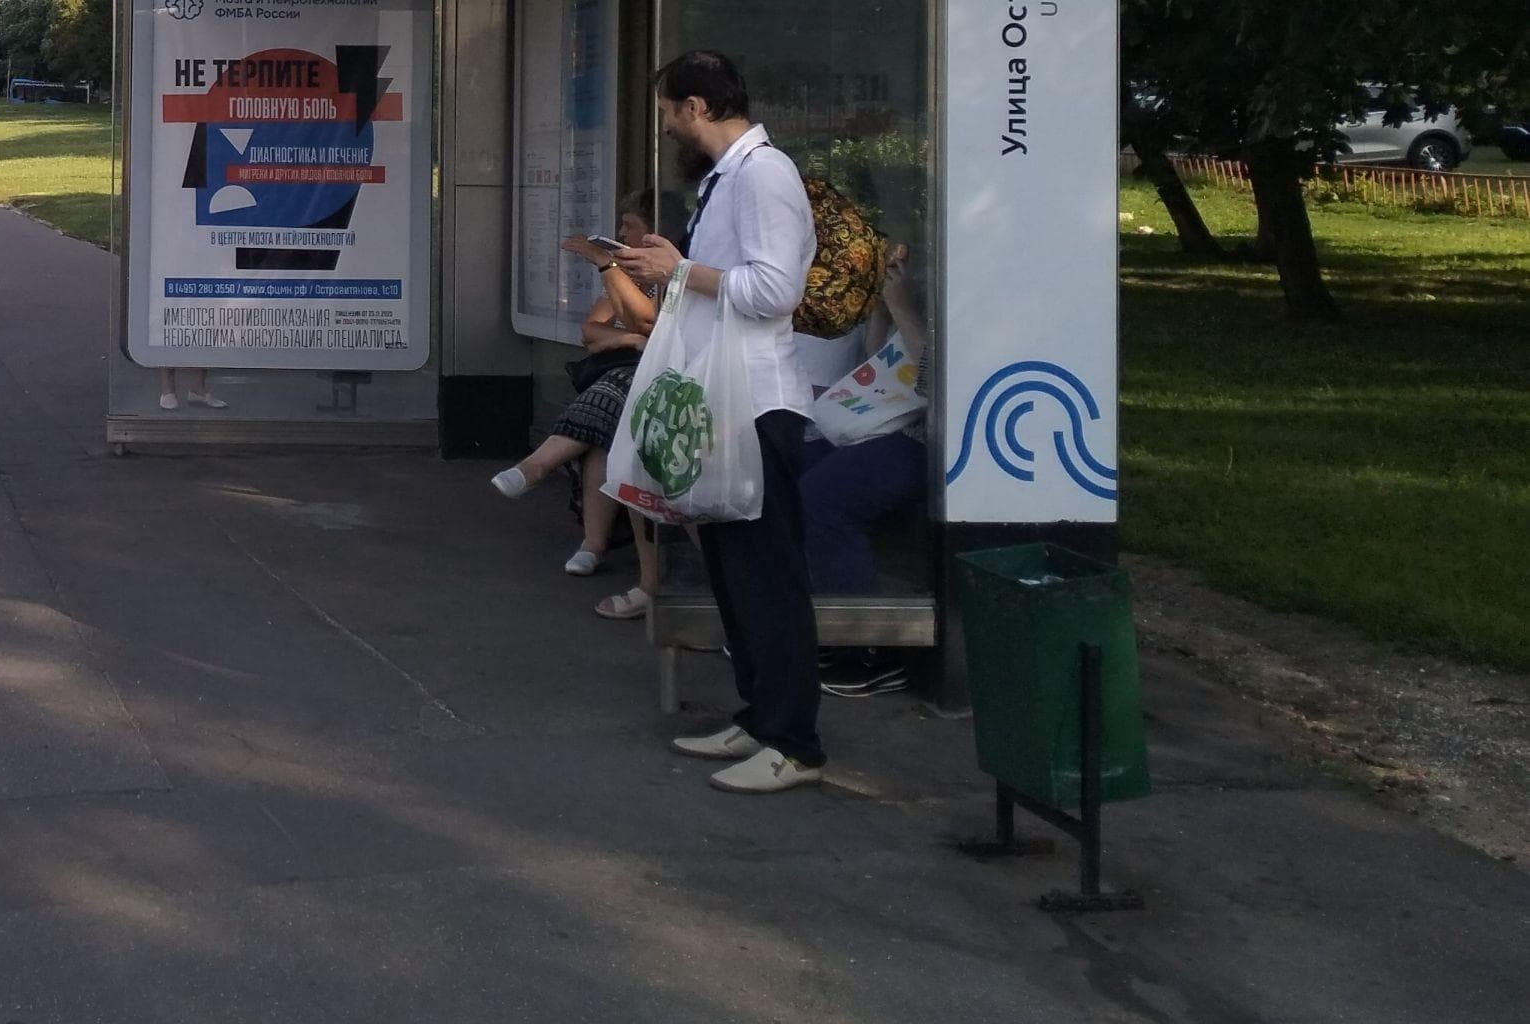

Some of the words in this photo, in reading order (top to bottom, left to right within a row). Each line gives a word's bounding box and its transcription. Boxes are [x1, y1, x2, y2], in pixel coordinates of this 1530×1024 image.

[214, 8, 253, 18] ФМБА
[256, 8, 301, 19] России
[174, 59, 206, 88] НЕ
[213, 59, 320, 88] ТЕРПИТЕ
[229, 96, 300, 120] ГОЛОВНУЮ
[303, 97, 337, 120] БОЛЬ
[1001, 57, 1031, 156] Улица
[249, 146, 317, 164] ДИАГНОСТИКА
[319, 147, 327, 163] И
[328, 147, 370, 163] ЛЕЧЕНИЕ
[210, 231, 216, 245] В
[218, 231, 247, 246] ЦЕНТРЕ
[248, 232, 274, 245] МОЗГА
[275, 232, 281, 245] И
[282, 230, 356, 246] НЕЙРОТЕХНОЛОГИЙ
[168, 283, 174, 294] 8
[175, 283, 197, 294] (495)
[198, 283, 213, 294] 280
[214, 283, 236, 294] 3550
[163, 308, 215, 326] ИМЕЮТСЯ
[219, 308, 330, 327] ПРОТИВОПОКАЗАНИЯ
[163, 328, 236, 349] НЕОБХОДИМА
[240, 329, 323, 349] КОНСУЛЬТАЦИЯ
[326, 329, 402, 350] СПЕЦИАЛИСТА
